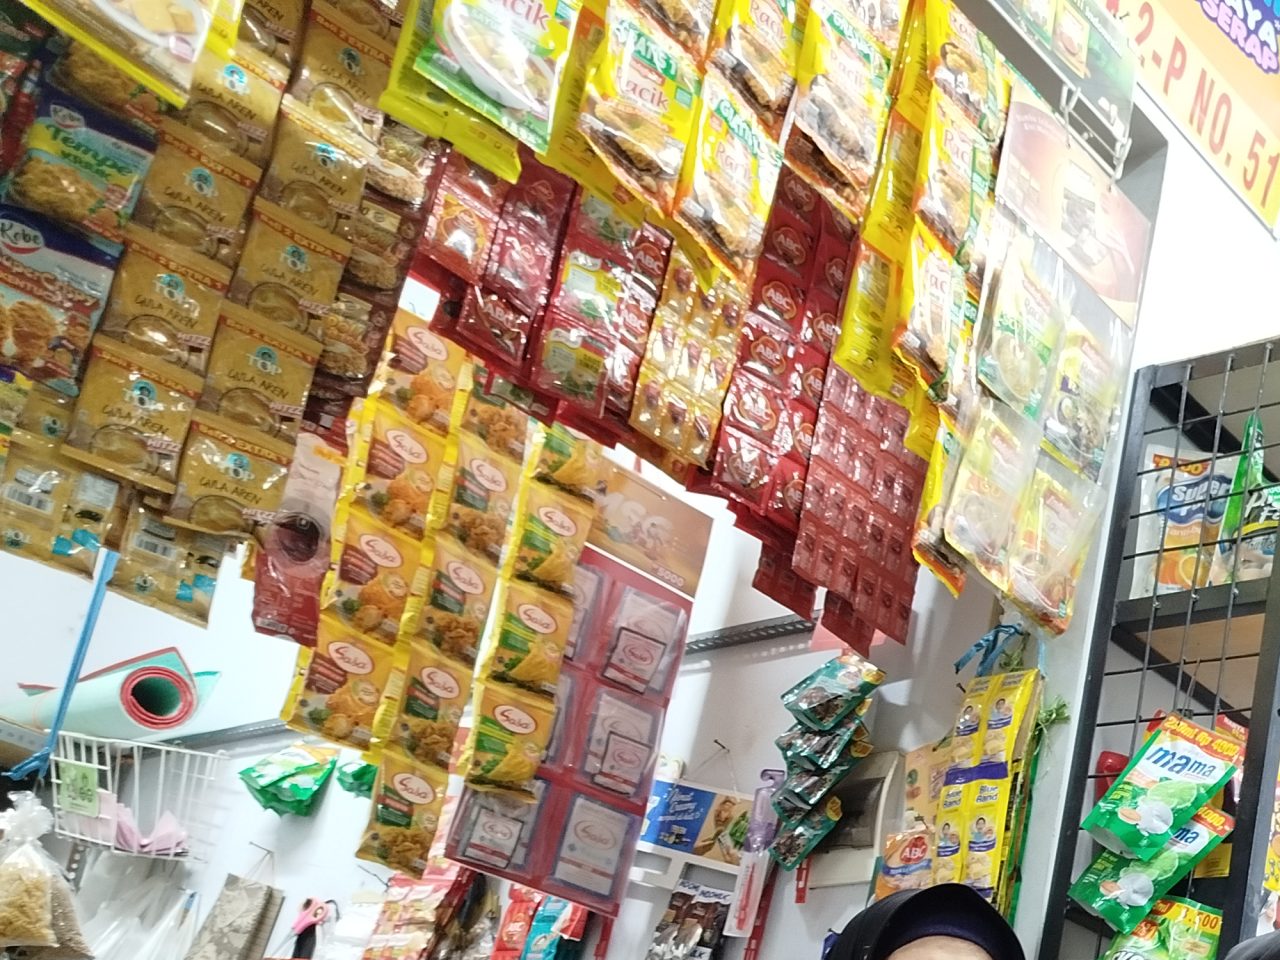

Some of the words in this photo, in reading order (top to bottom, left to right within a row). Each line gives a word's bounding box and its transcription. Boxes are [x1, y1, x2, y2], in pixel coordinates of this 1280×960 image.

[1201, 0, 1279, 71] SERAP
[45, 124, 133, 176] Tempe
[1188, 67, 1232, 169] NO.
[1243, 129, 1280, 209] 51
[0, 221, 41, 246] Kobe
[766, 289, 792, 306] ABC
[1146, 746, 1217, 779] mama
[901, 843, 928, 859] ABC
